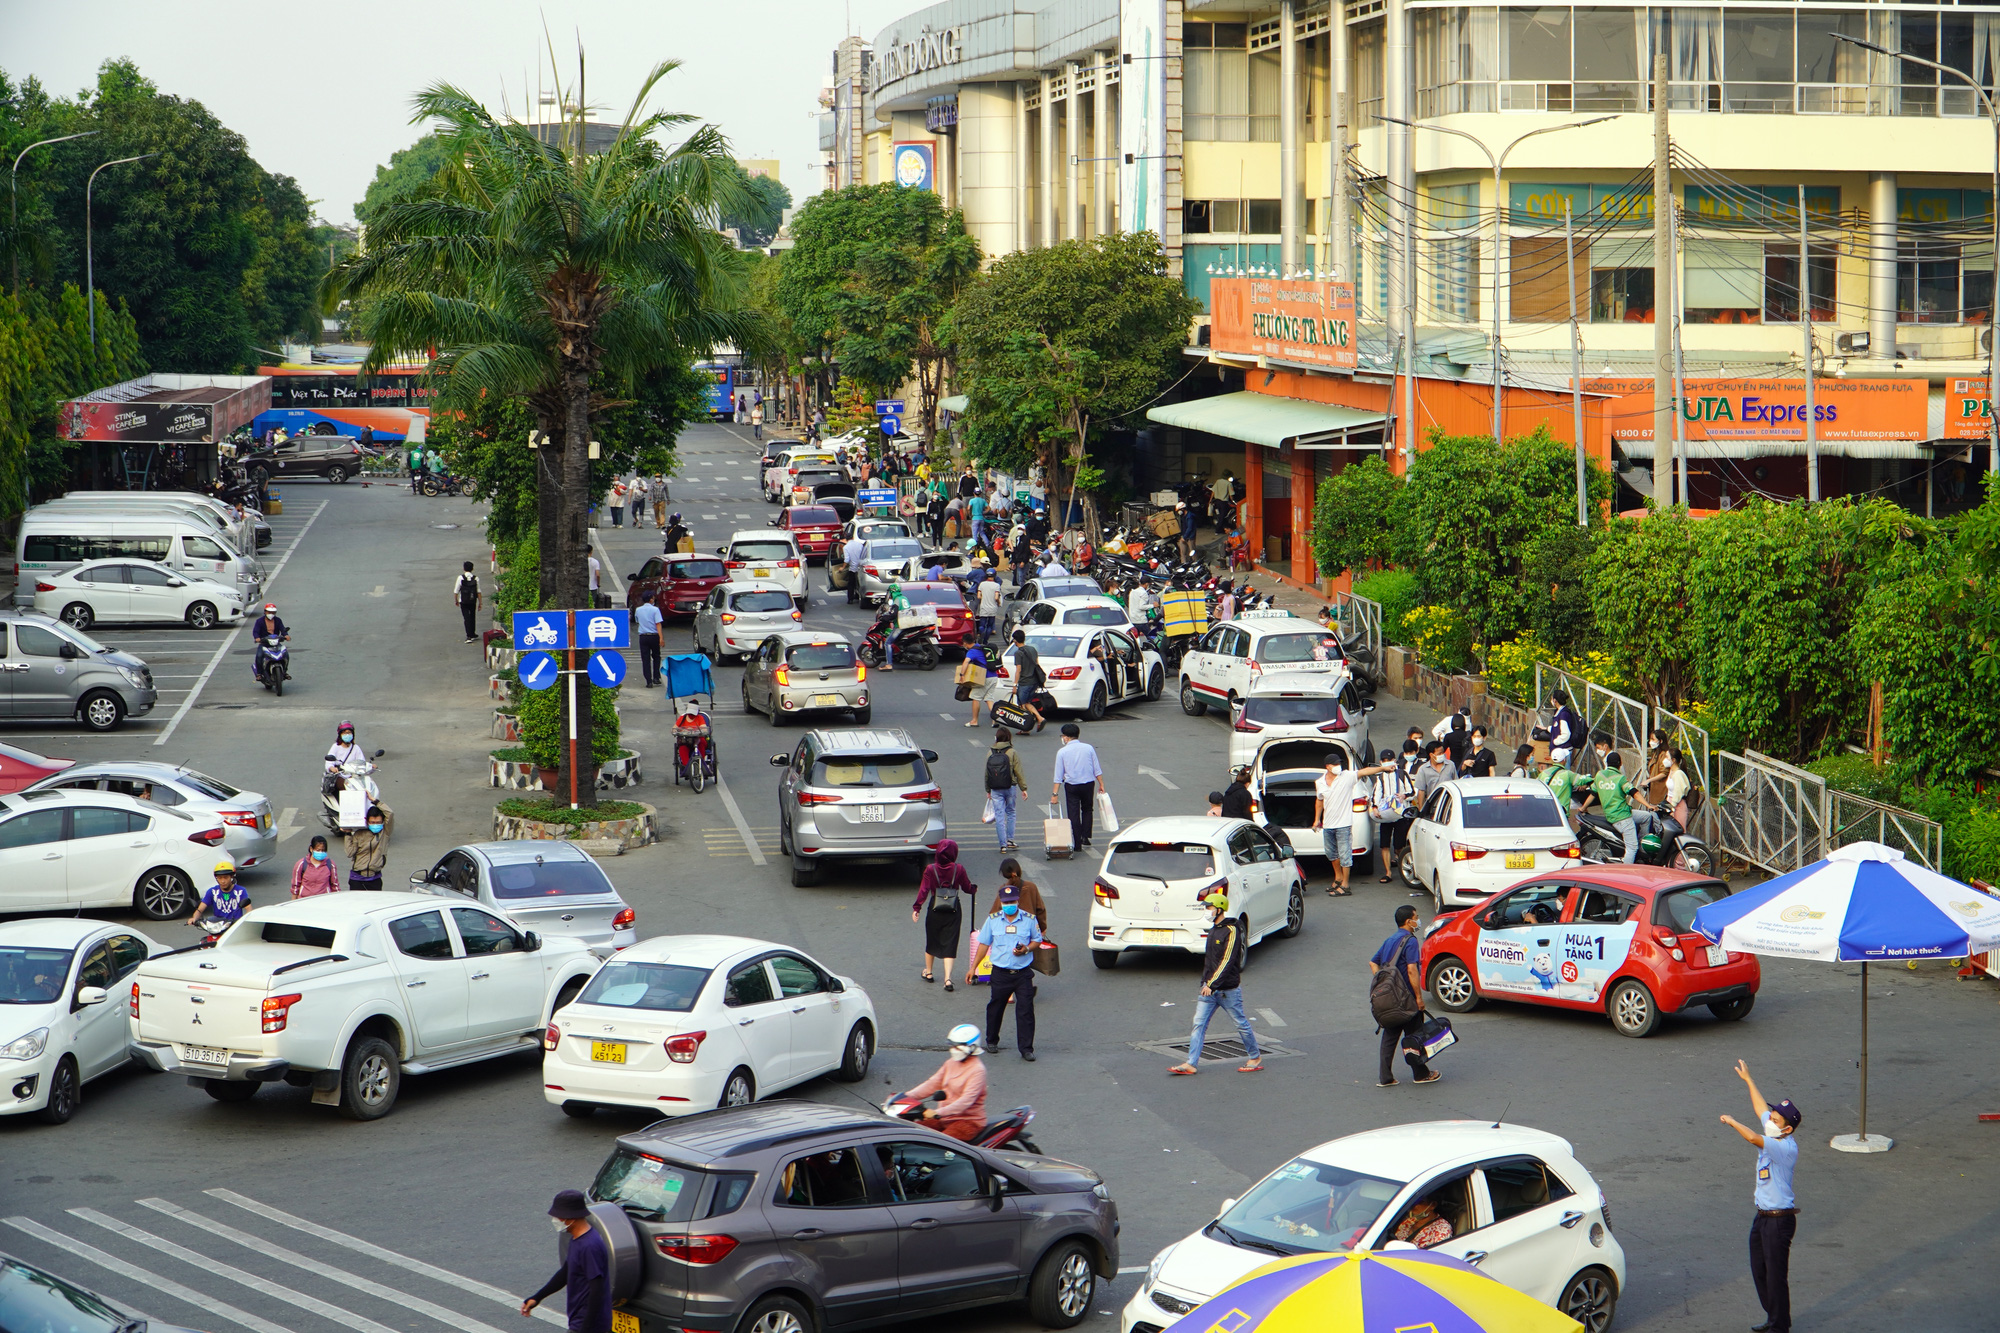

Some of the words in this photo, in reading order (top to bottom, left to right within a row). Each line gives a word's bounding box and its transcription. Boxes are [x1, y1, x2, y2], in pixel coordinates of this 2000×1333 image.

[906, 24, 962, 76] ĐÔNG
[1253, 308, 1300, 343] PHƯƠNG
[1585, 382, 1613, 391] CÔNG
[1617, 383, 1626, 391] TY
[1701, 384, 1713, 392] VỤ
[1717, 380, 1756, 391] CHUYỂN
[1759, 382, 1781, 391] PHÁT
[1892, 384, 1913, 392] FUTA
[371, 386, 406, 398] HOÀNG
[114, 411, 136, 422] STING
[1741, 397, 1837, 426] Express
[174, 413, 196, 424] STING
[1615, 429, 1639, 437] 1900
[1825, 429, 1919, 438] www.futaexpress.vn
[1005, 710, 1026, 725] YONEX
[1599, 780, 1616, 790] Grab
[865, 805, 878, 813] 51H
[1566, 933, 1592, 946] MUA
[1595, 936, 1605, 960] 1
[1888, 948, 1902, 956] Nơi
[1903, 947, 1918, 955] hút
[1919, 946, 1942, 954] thuốc
[1565, 947, 1593, 961] TẶNG
[601, 1044, 616, 1052] 51F
[594, 1052, 622, 1063] 451.23
